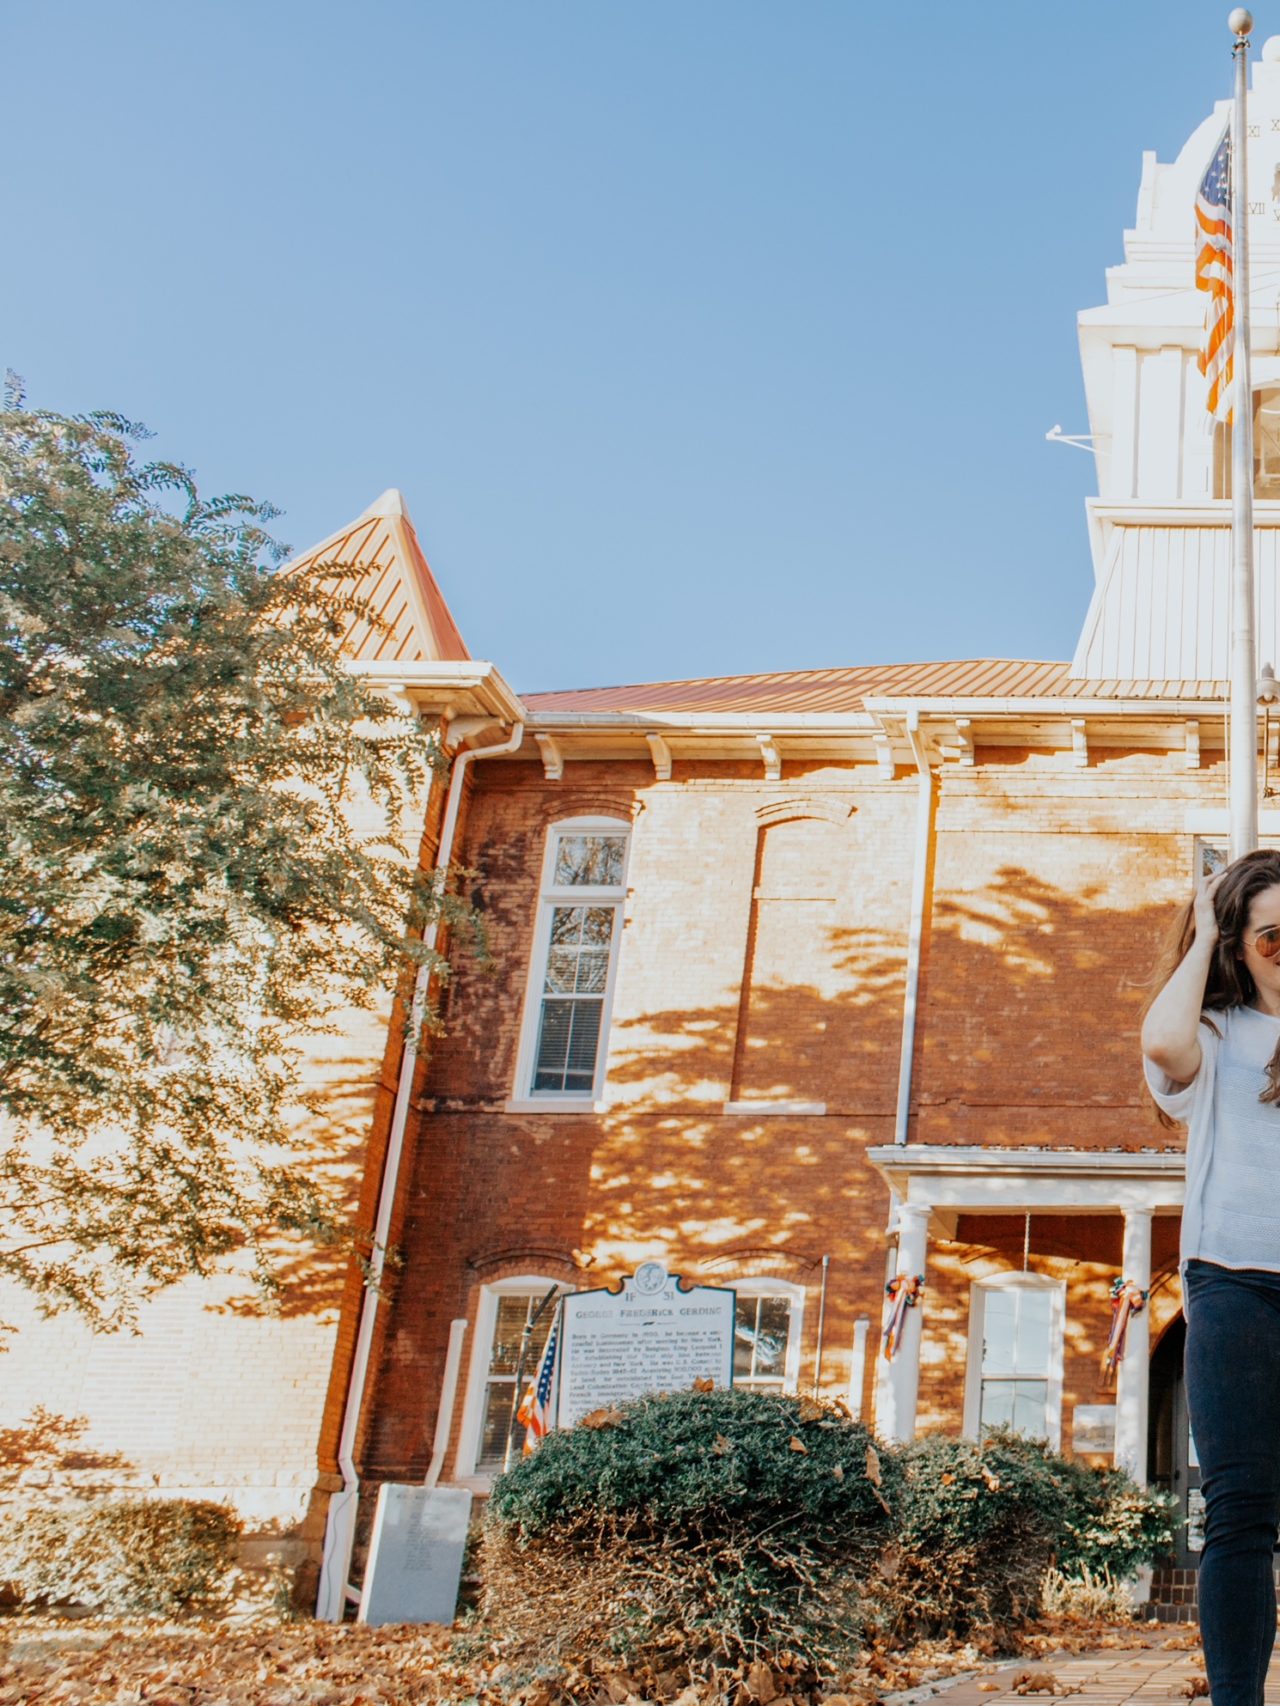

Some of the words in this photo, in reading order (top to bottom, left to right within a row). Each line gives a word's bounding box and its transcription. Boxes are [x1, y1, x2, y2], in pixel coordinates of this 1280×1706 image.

[1248, 202, 1265, 215] VII
[620, 1308, 674, 1318] FREDERICK
[679, 1306, 722, 1316] GERDING
